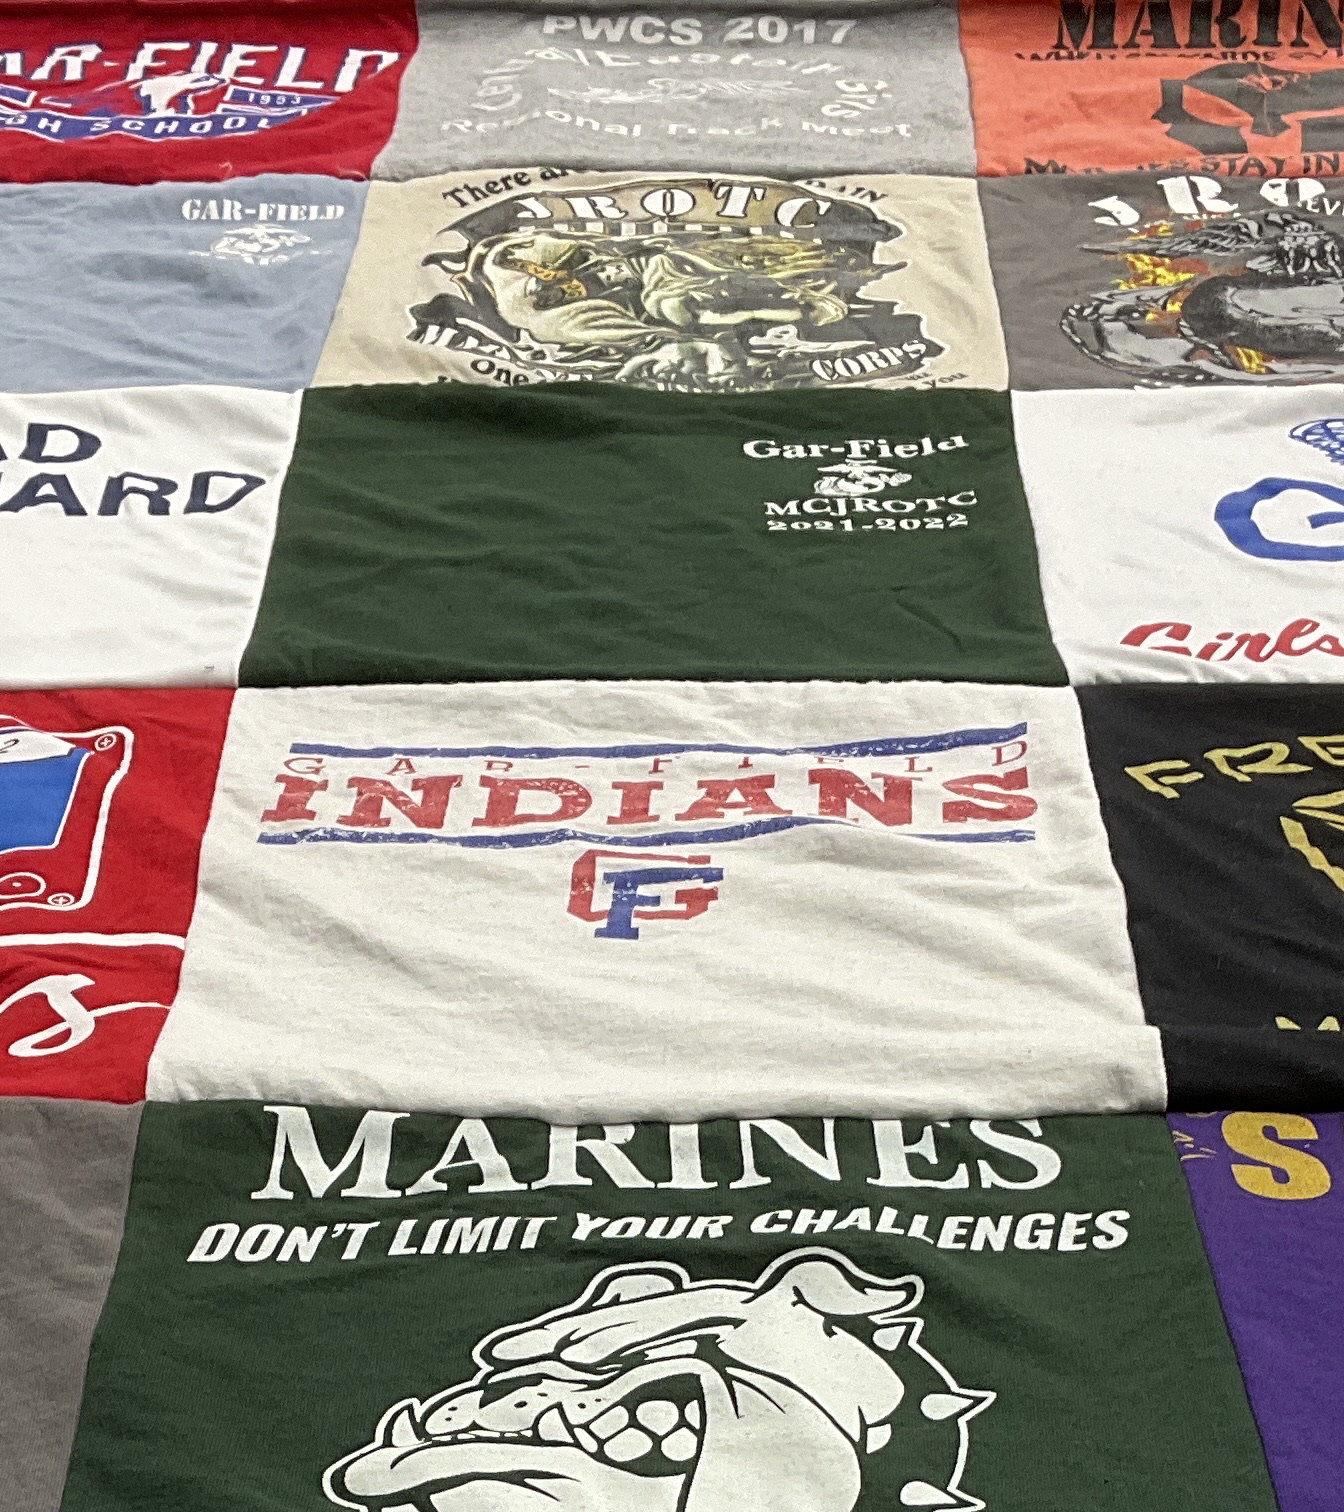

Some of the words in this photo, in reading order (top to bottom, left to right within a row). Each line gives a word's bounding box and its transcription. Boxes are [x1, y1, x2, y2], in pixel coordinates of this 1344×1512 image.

[542, 15, 703, 46] PWCS
[722, 15, 859, 45] 2017
[90, 112, 274, 135] SCHOOL
[1302, 153, 1341, 176] IN
[442, 170, 532, 208] There
[513, 183, 832, 229] JROTC
[181, 199, 345, 221] GAR-FIELD
[810, 339, 928, 381] CORPS
[743, 435, 970, 459] Gar-Field
[763, 490, 978, 516] MCJROTC
[766, 513, 969, 532] 2021-2022
[283, 739, 1029, 776] GAR-FILD
[260, 765, 1039, 829] INDIANS
[251, 1104, 1064, 1199] MARINES
[187, 1220, 380, 1263] DON'T
[386, 1213, 558, 1255] LIMIT
[570, 1211, 727, 1244] YOUR
[758, 1205, 1131, 1253] CHALLENGES
